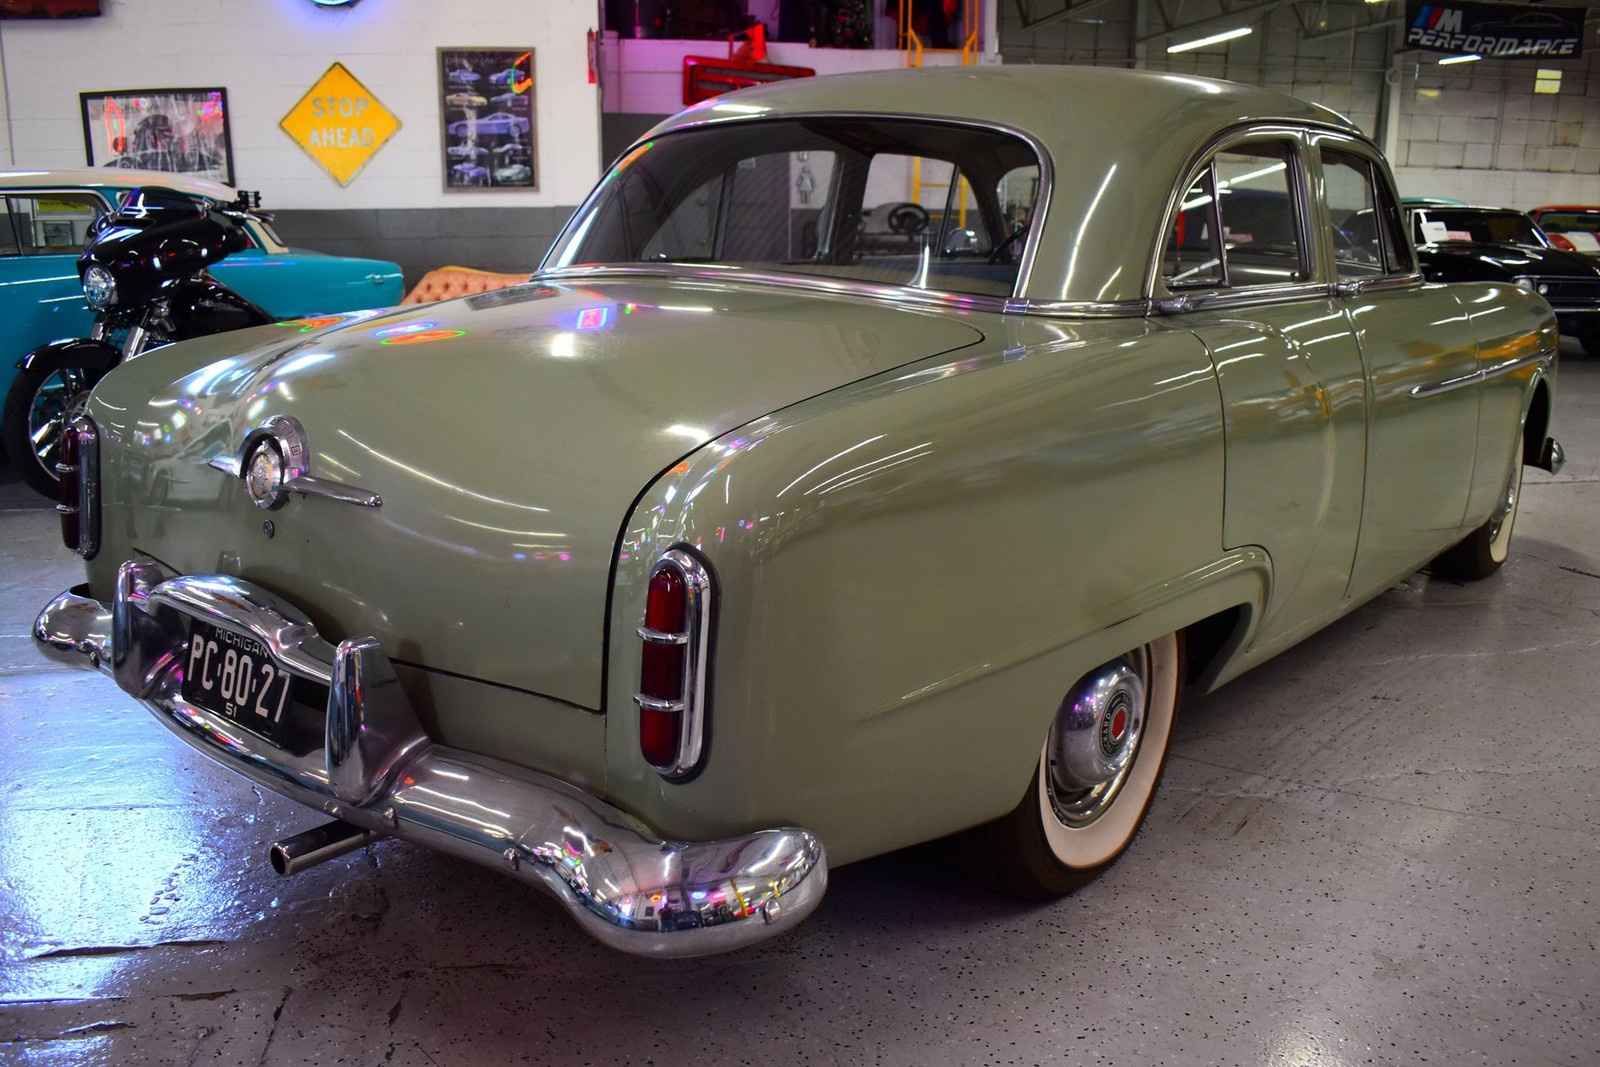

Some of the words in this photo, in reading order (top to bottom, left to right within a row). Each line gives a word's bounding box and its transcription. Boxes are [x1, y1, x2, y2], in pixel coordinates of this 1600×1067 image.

[1408, 28, 1578, 56] PERFORMANCE
[312, 97, 370, 118] STOP
[309, 127, 374, 148] AHEAD
[215, 627, 268, 658] MICHIGAN
[225, 702, 237, 717] 51
